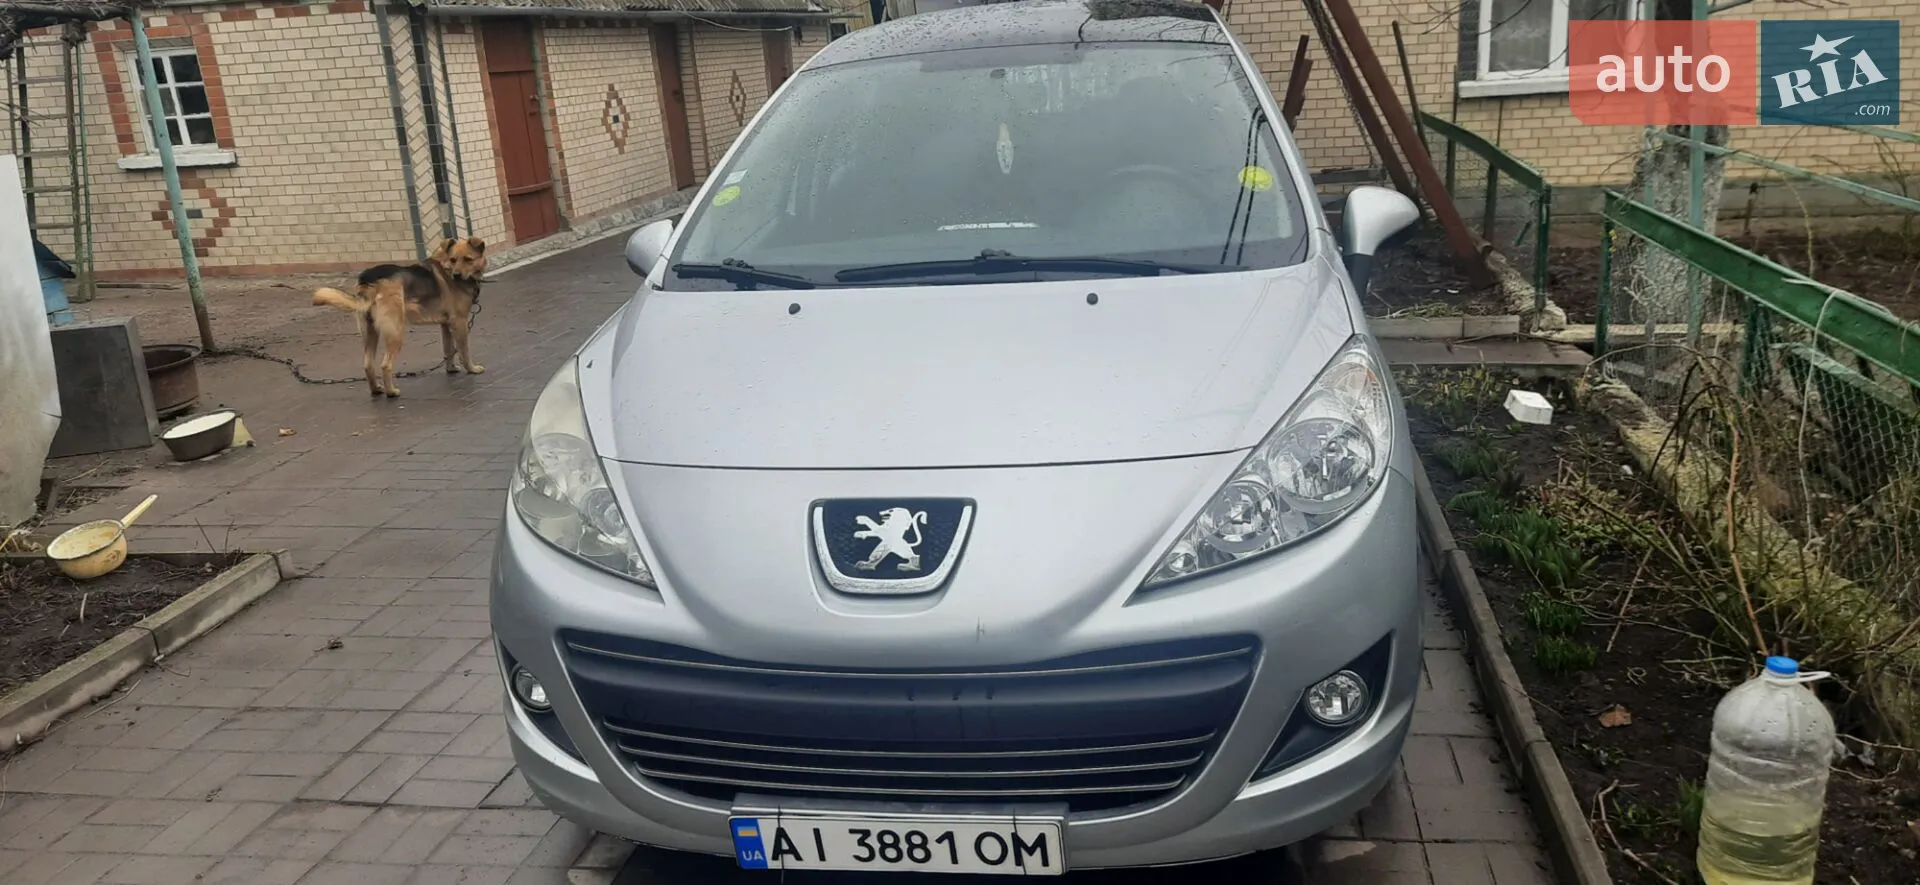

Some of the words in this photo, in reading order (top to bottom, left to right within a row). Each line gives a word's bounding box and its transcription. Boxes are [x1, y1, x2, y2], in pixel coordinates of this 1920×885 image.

[742, 850, 765, 861] UA
[771, 826, 827, 862] AI
[848, 828, 959, 865] 3881
[974, 831, 1050, 867] OM
